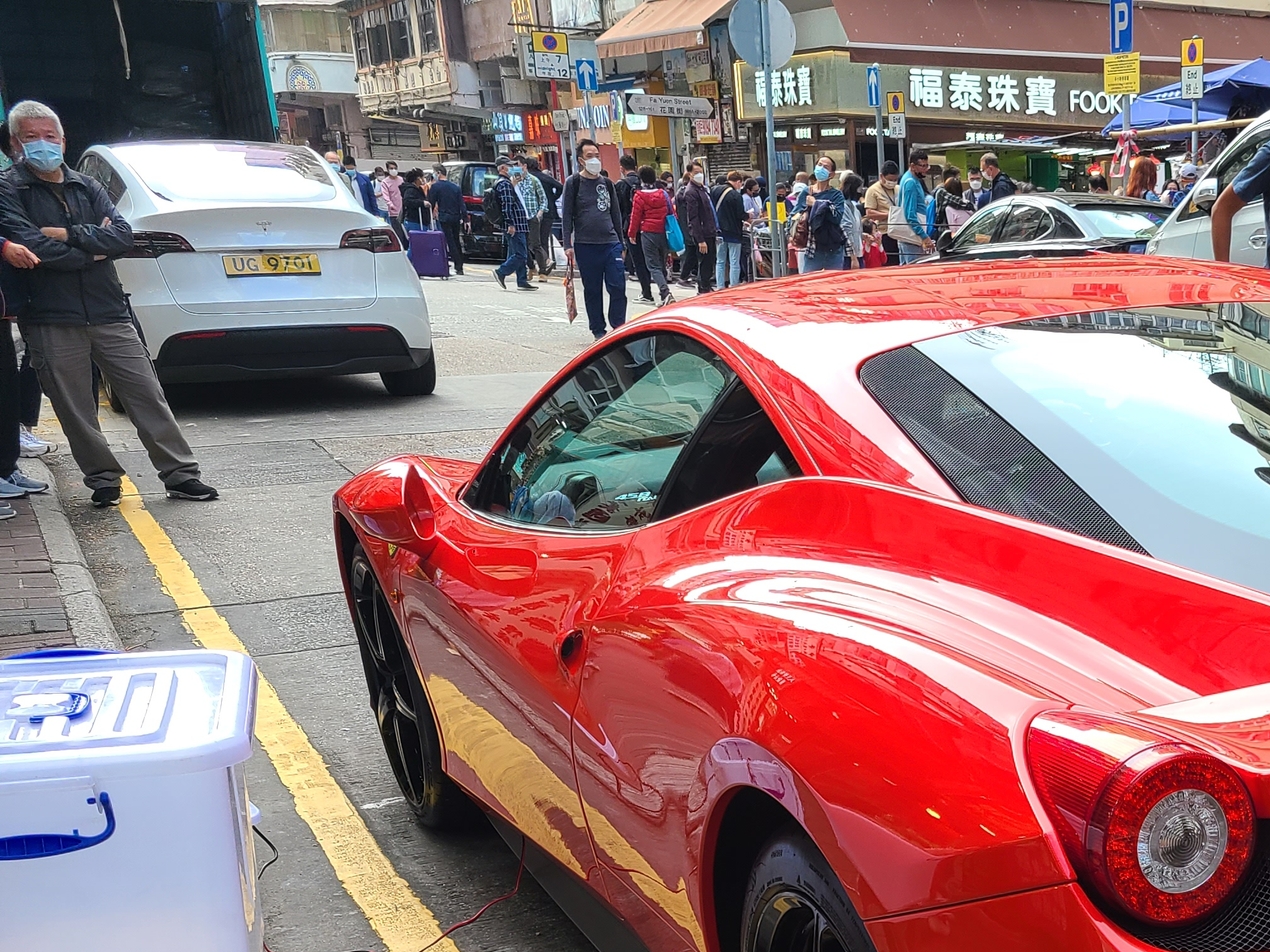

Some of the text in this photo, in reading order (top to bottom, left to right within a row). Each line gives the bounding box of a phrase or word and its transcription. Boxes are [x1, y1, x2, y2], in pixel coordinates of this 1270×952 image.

[555, 55, 562, 63] 7
[557, 69, 568, 77] 12
[1187, 70, 1198, 80] End
[909, 68, 1057, 116] 福泰珠寶
[1069, 89, 1123, 114] FOOK
[892, 115, 901, 124] End
[231, 255, 313, 272] UG 9701
